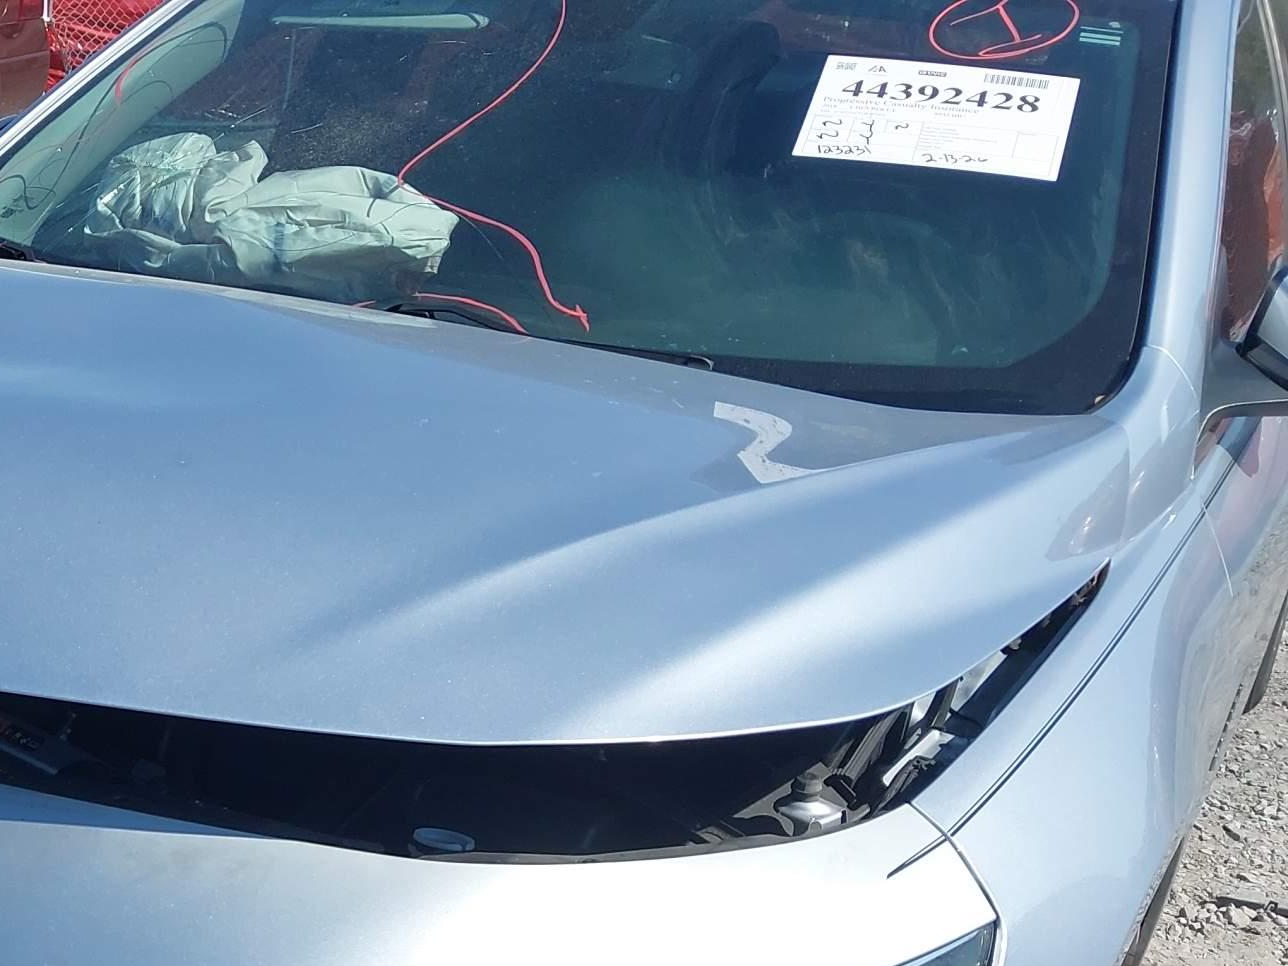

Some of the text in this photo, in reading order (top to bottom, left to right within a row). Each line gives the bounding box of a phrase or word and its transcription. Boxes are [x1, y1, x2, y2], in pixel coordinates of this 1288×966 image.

[823, 96, 979, 113] Progressive Casualty Insurance
[841, 79, 1041, 113] 44392428
